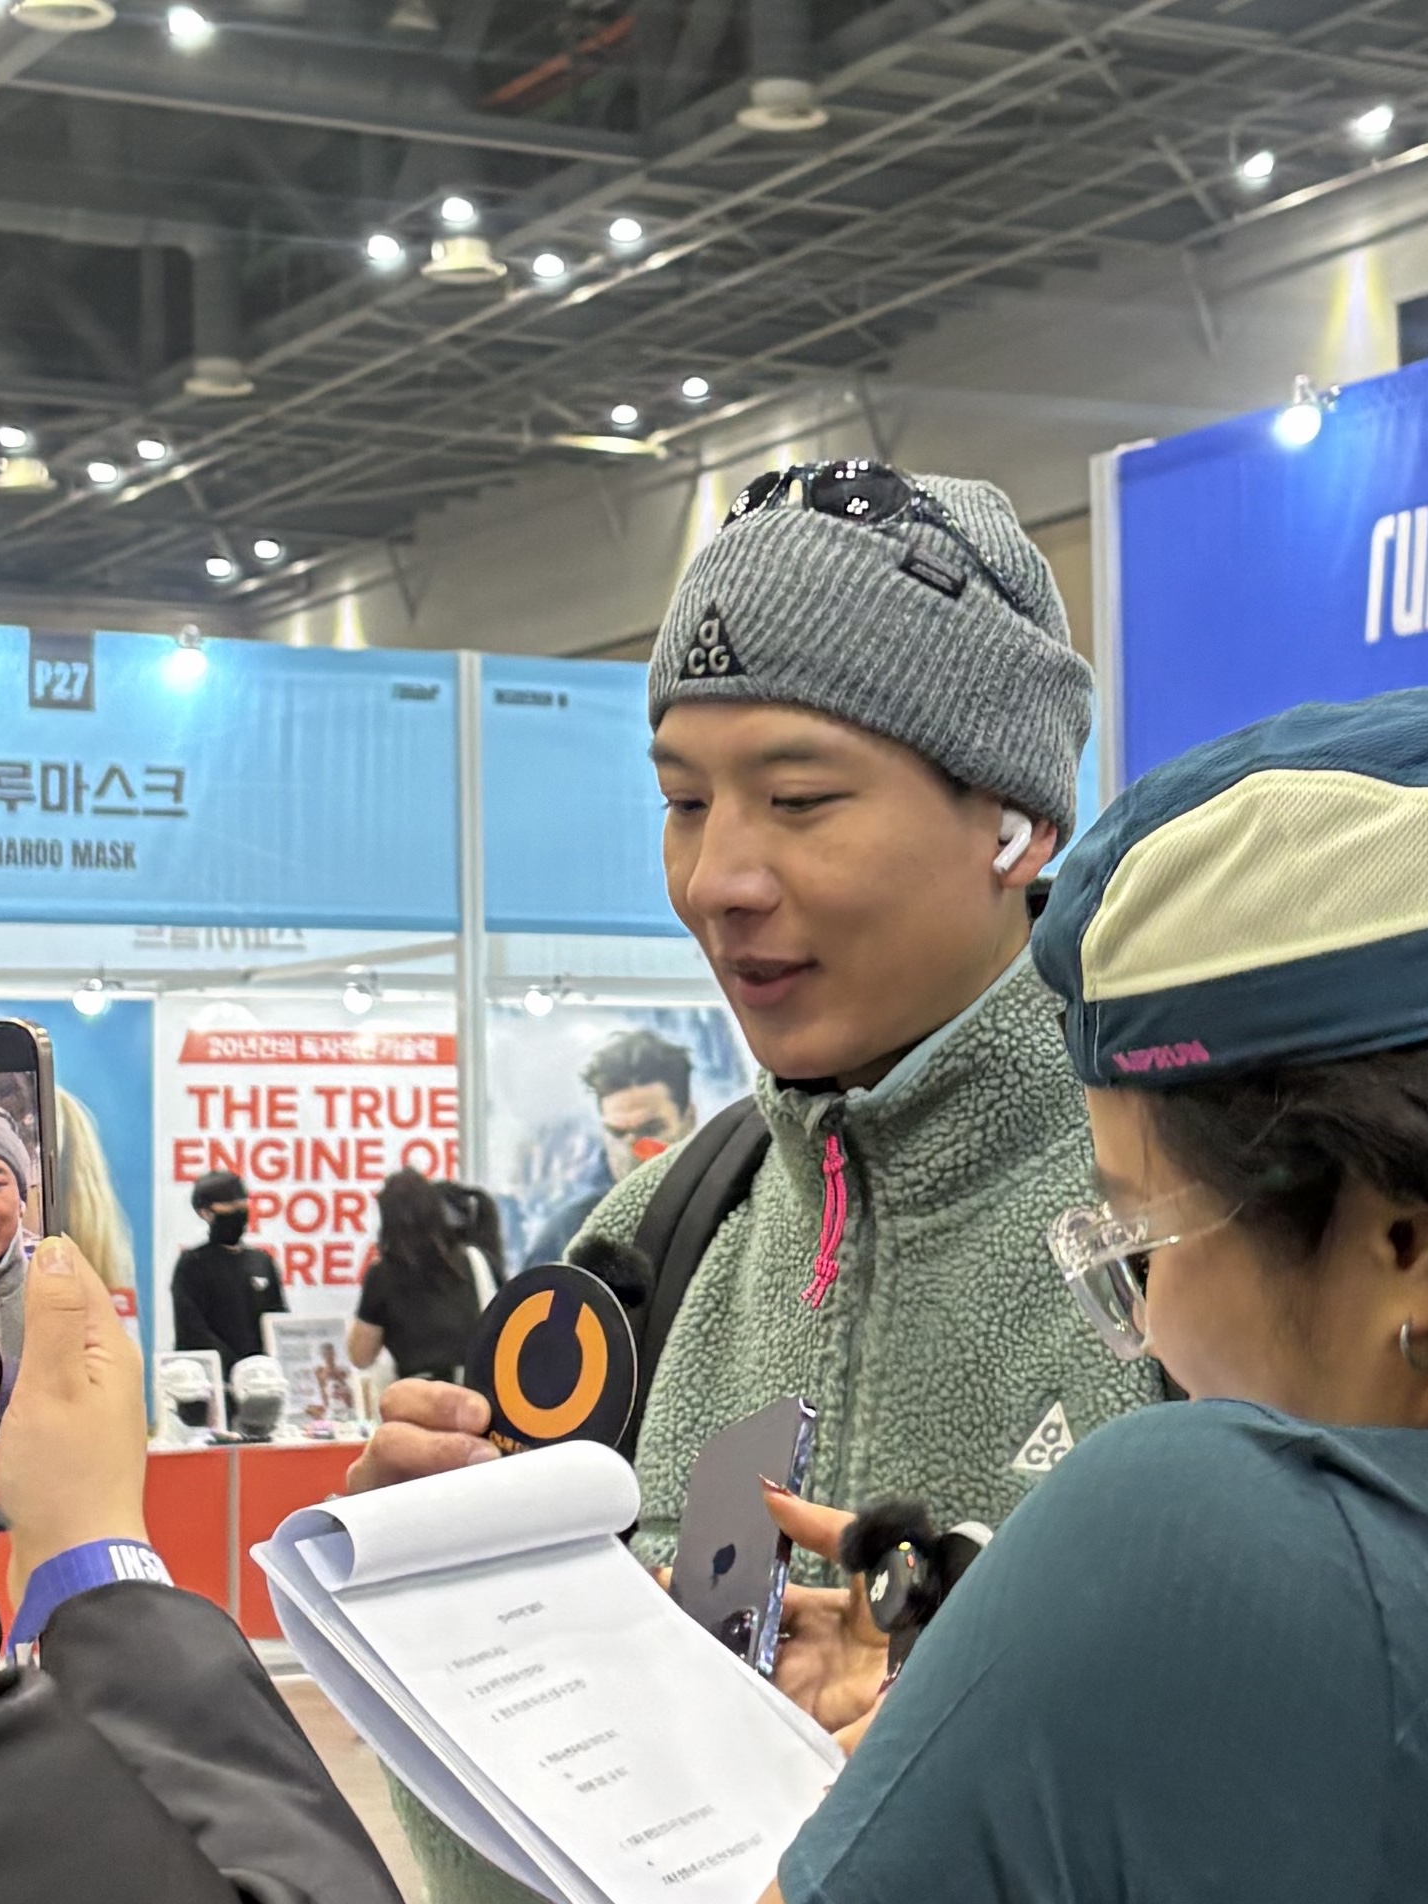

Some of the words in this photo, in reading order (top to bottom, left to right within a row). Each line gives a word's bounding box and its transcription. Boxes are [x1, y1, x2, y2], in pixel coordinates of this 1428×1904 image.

[34, 660, 89, 701] P27
[72, 840, 137, 869] MASK
[186, 1084, 298, 1129] THE
[313, 1085, 458, 1130] TRUE
[173, 1137, 385, 1183] ENGINE
